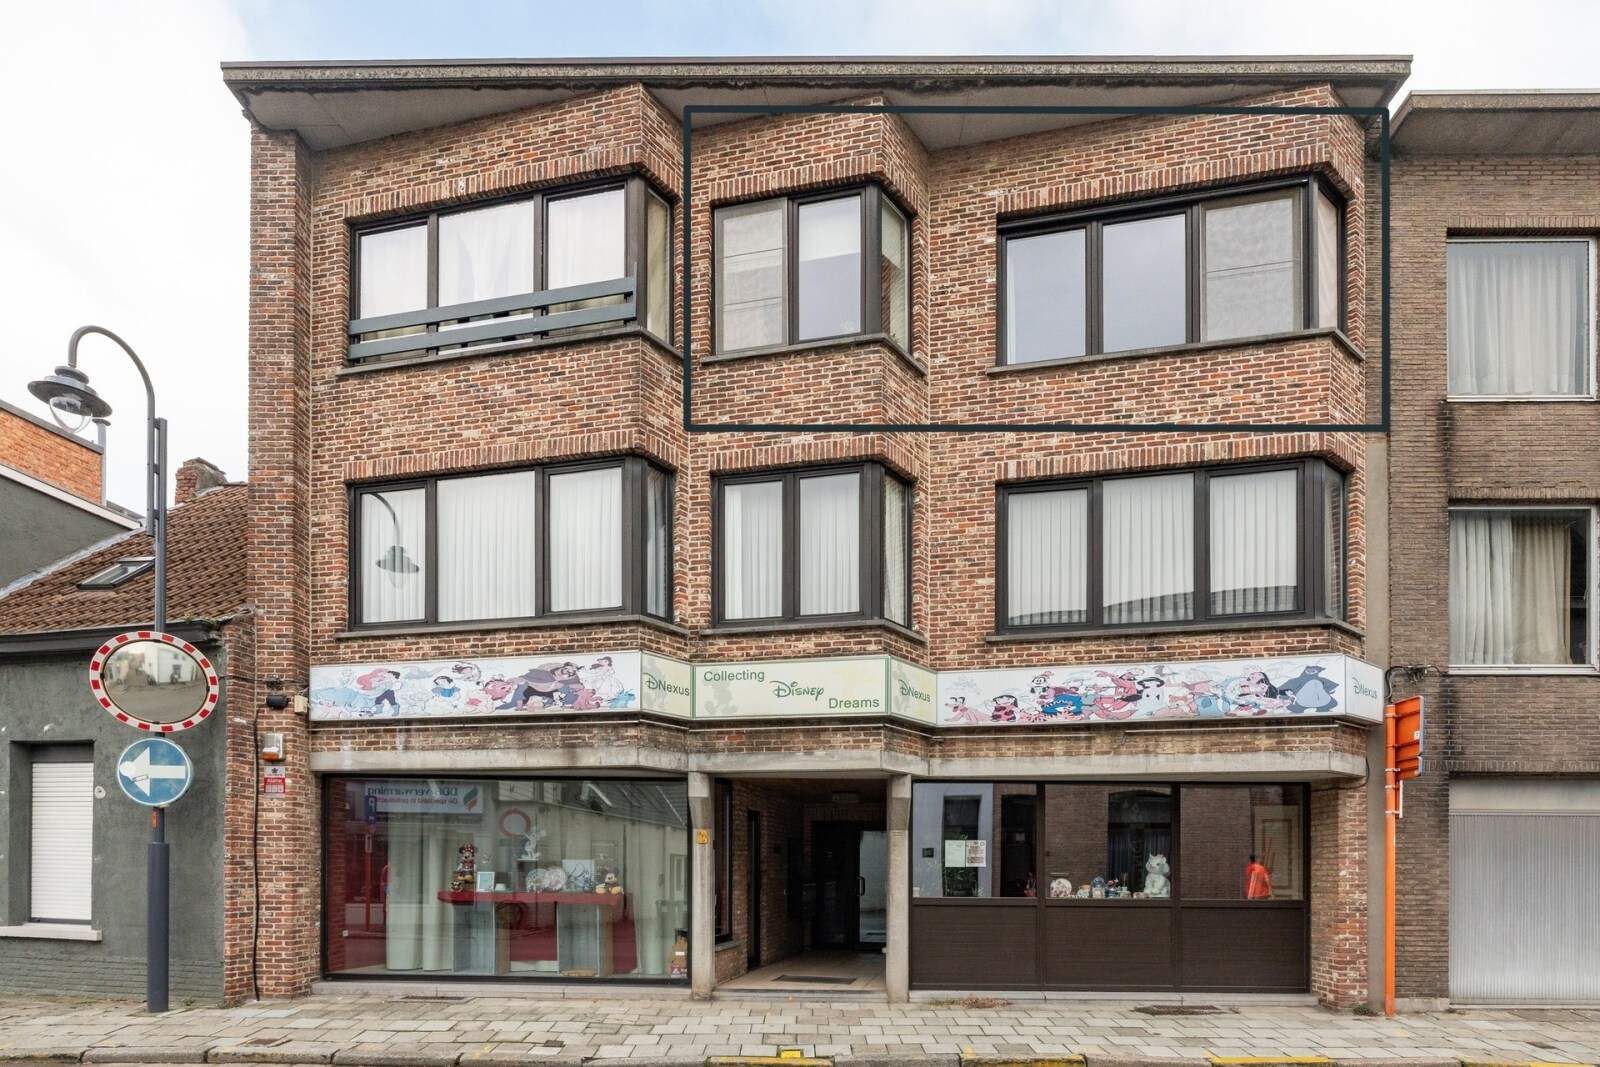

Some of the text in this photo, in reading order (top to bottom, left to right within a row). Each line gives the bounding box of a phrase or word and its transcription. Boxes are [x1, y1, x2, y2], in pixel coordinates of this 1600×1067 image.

[643, 672, 690, 697] DNexus
[703, 669, 765, 683] Collecting
[898, 679, 931, 703] DNexus
[828, 698, 880, 709] Dreams
